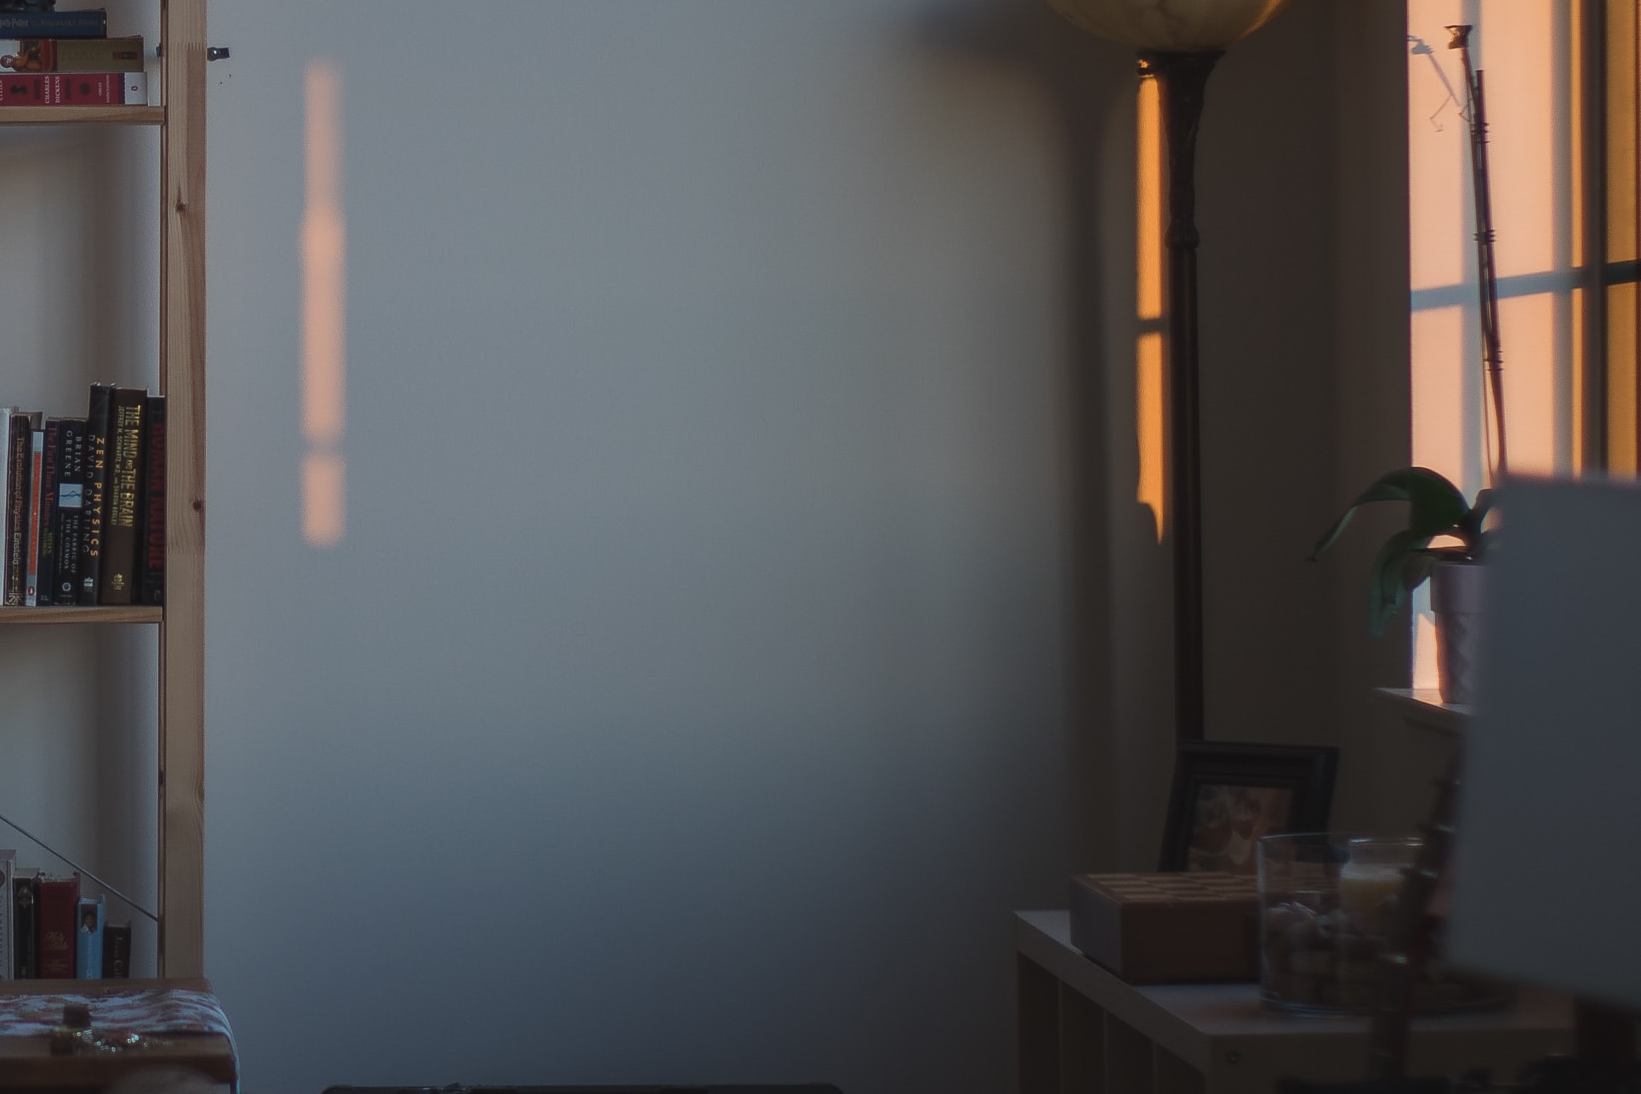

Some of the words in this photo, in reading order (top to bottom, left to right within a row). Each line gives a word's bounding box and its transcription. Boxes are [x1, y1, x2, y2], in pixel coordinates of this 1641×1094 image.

[125, 405, 140, 425] THE
[16, 437, 24, 453] The
[64, 430, 73, 477] GREENE
[74, 436, 82, 472] BRIAN
[86, 434, 95, 479] DAVID
[95, 437, 105, 469] ZEN
[123, 429, 138, 459] MIND
[15, 453, 24, 490] Evolution
[120, 469, 137, 490] THE
[15, 490, 23, 500] of
[118, 493, 134, 527] BRAIN
[13, 500, 22, 531] Physics
[82, 489, 92, 554] DARLING
[90, 482, 103, 558] PHYSICS
[12, 532, 21, 565] Einstein
